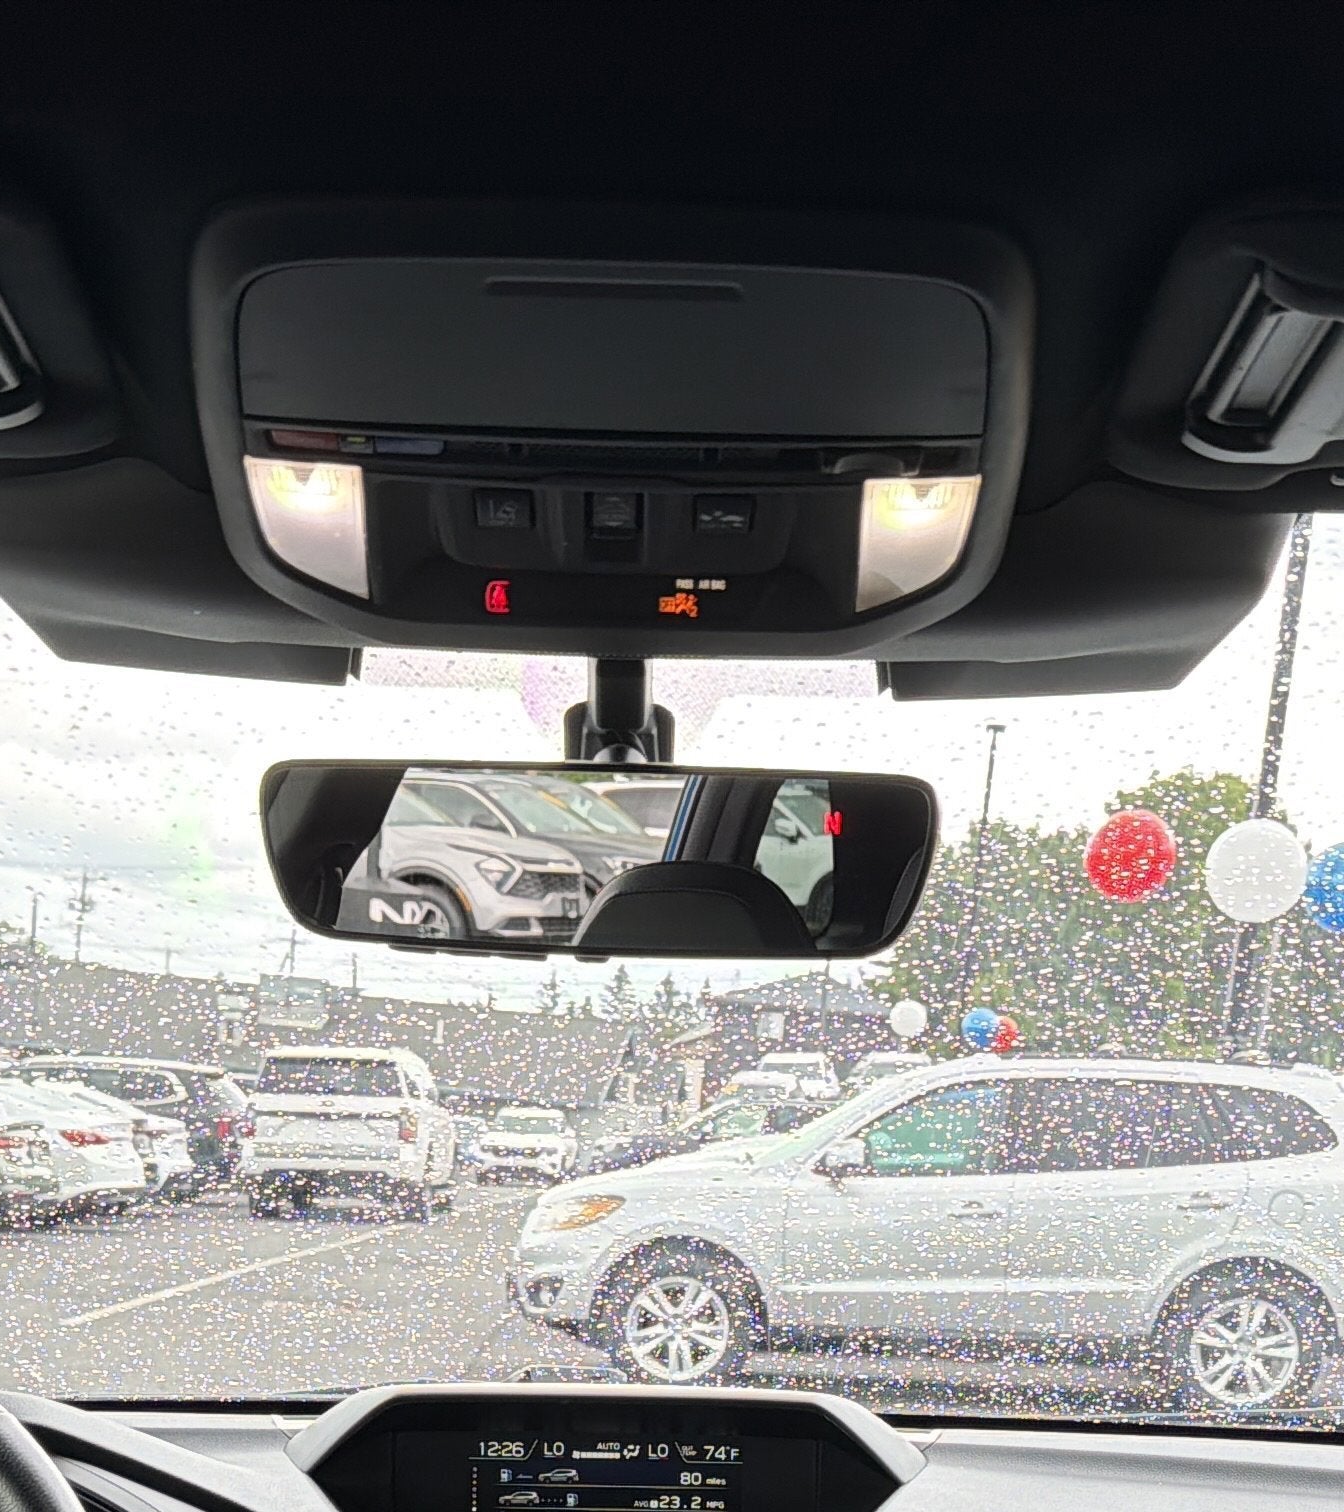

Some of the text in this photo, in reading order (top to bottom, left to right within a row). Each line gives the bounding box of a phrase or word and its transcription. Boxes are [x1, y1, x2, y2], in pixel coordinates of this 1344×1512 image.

[824, 811, 842, 835] N
[479, 1441, 669, 1458] 12:26 LO AUTO LO
[680, 1472, 702, 1486] 80
[634, 1500, 649, 1508] AVG
[659, 1495, 702, 1509] 23.2
[706, 1501, 725, 1509] MPG
